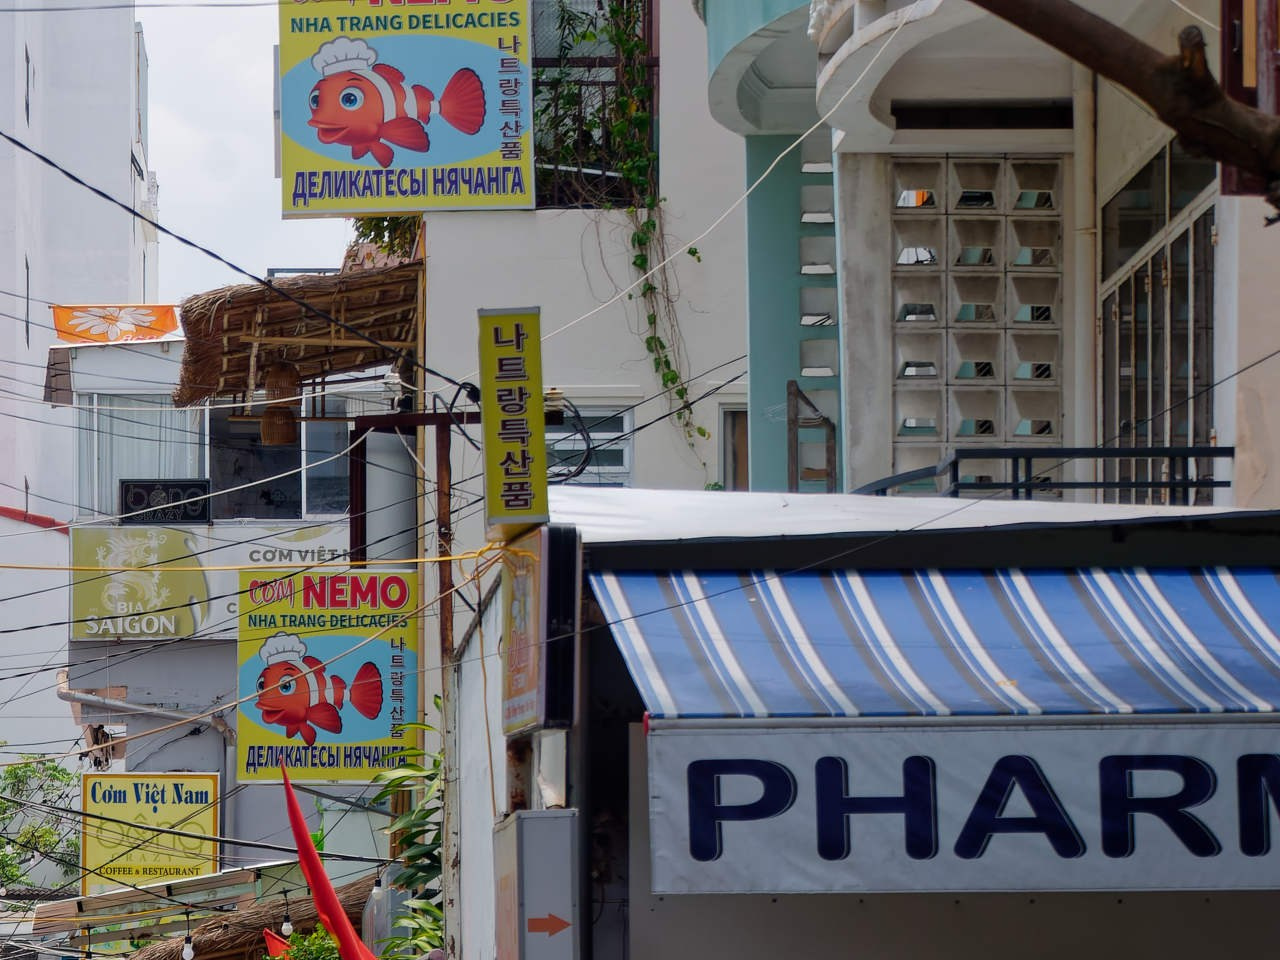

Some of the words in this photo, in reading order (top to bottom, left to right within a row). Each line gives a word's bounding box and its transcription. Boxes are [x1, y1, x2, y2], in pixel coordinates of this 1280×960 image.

[291, 18, 331, 33] NHA
[336, 15, 402, 32] TRANG
[408, 12, 521, 30] DELICACIES
[292, 168, 428, 207] ДЕЛИКАТЕСЫ
[432, 166, 525, 197] НЯЧАНГА
[249, 549, 293, 562] CƠM
[302, 575, 410, 610] NEMO
[116, 601, 144, 614] BIA
[85, 615, 177, 635] SAIGON
[248, 614, 277, 628] NHA
[280, 614, 327, 628] TRANG
[329, 614, 408, 628] DELICACIES
[246, 745, 340, 772] ДЕЛИКАТЕСЫ
[91, 781, 127, 805] Cơm
[132, 782, 168, 814] Việt
[170, 783, 209, 805] Nam
[99, 867, 134, 876] COFFEE
[142, 866, 201, 877] RESTAURANT
